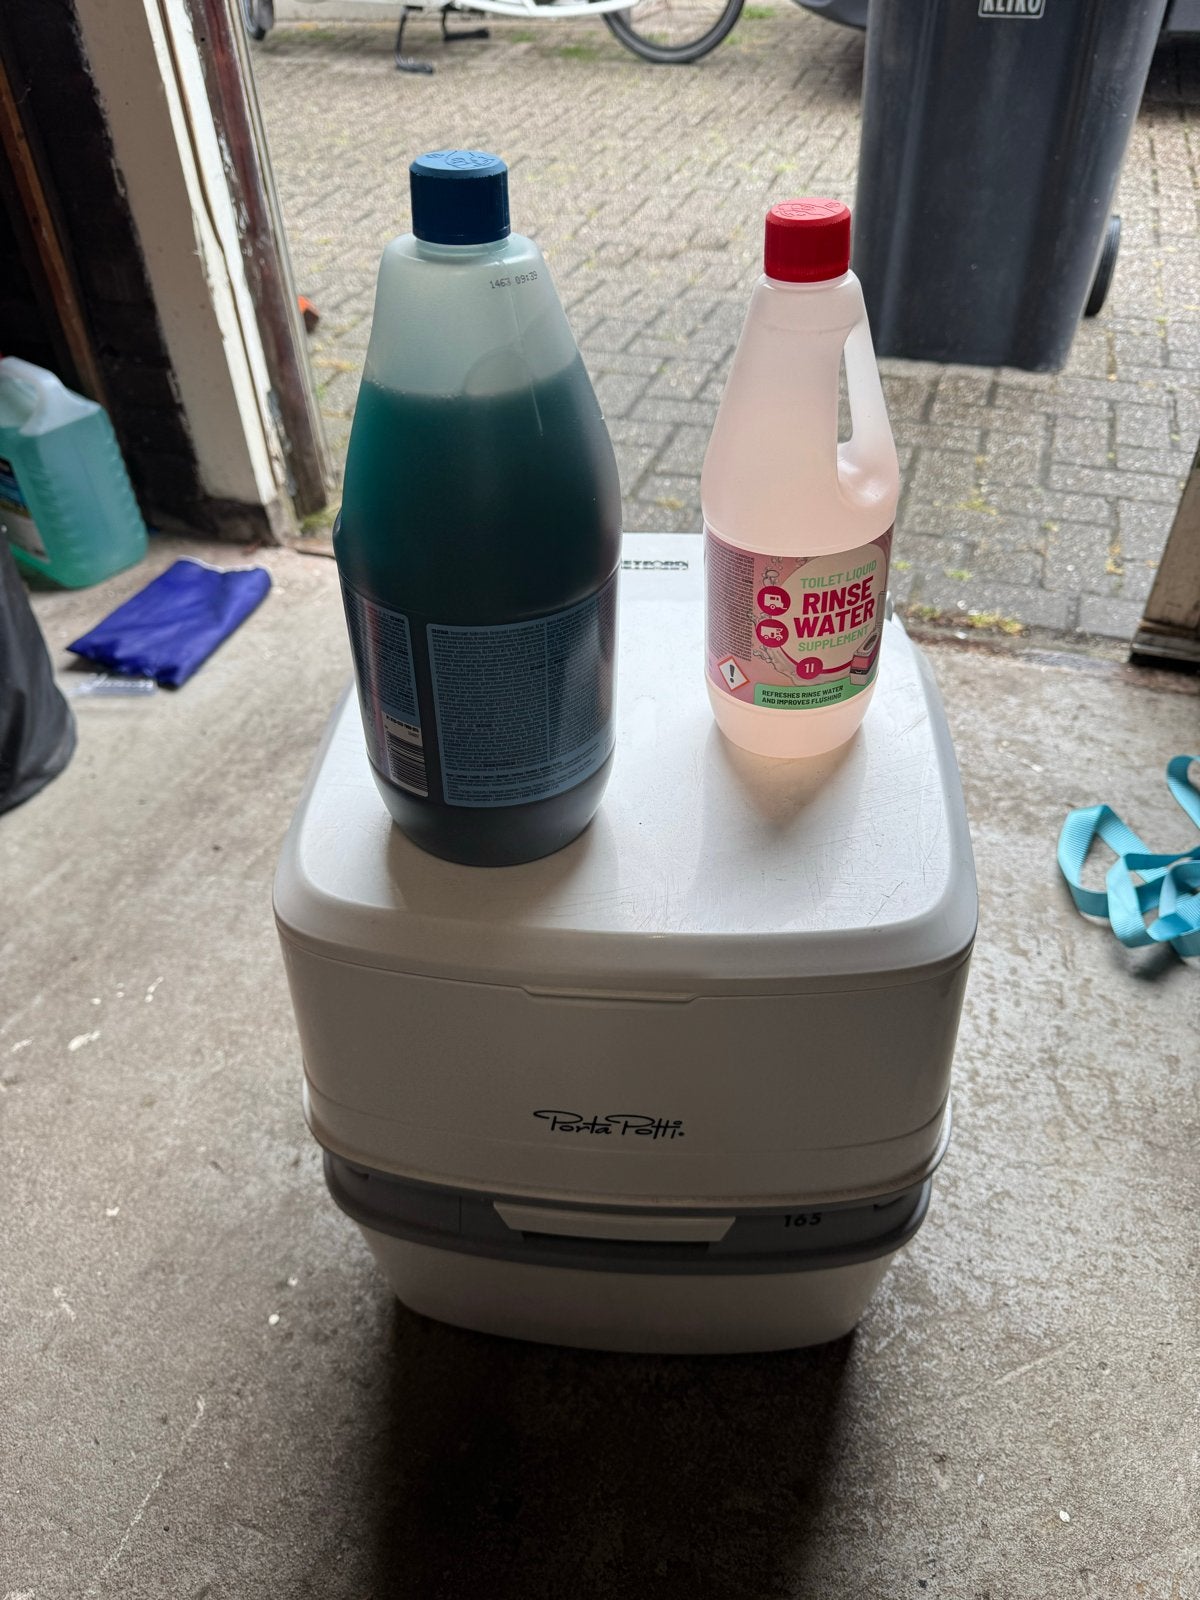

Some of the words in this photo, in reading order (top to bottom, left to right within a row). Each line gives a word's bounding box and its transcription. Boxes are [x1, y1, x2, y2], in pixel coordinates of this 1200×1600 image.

[489, 277, 511, 288] 1463
[514, 270, 538, 285] 09:39
[620, 560, 689, 571] ETFORD
[800, 572, 845, 589] TOILET
[846, 559, 877, 582] LIQUID
[802, 575, 874, 615] RINSE
[793, 598, 875, 639] WATER
[798, 624, 871, 652] SUPPLEMENT
[762, 689, 800, 699] REFRESHES
[801, 690, 821, 699] RINSE
[822, 685, 844, 695] WATER
[811, 692, 842, 705] FLUSHING
[533, 1109, 613, 1135] Porta
[784, 1212, 823, 1228] 165
